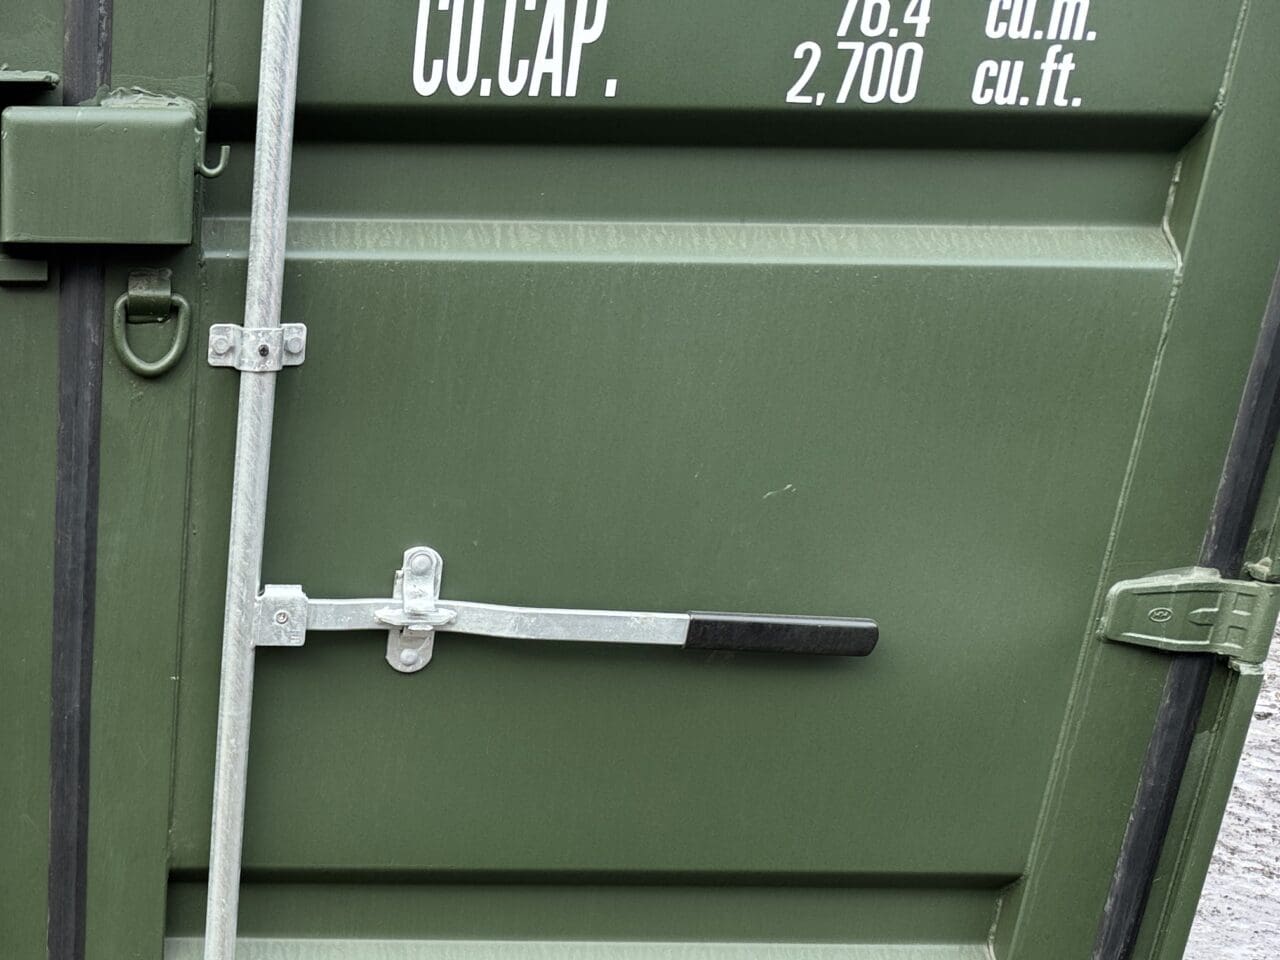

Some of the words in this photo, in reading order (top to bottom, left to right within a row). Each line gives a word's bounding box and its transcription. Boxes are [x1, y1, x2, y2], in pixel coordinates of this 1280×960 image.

[984, 0, 1098, 41] cu.m.
[785, 41, 924, 106] 2,700
[971, 44, 1083, 107] cu.ft.
